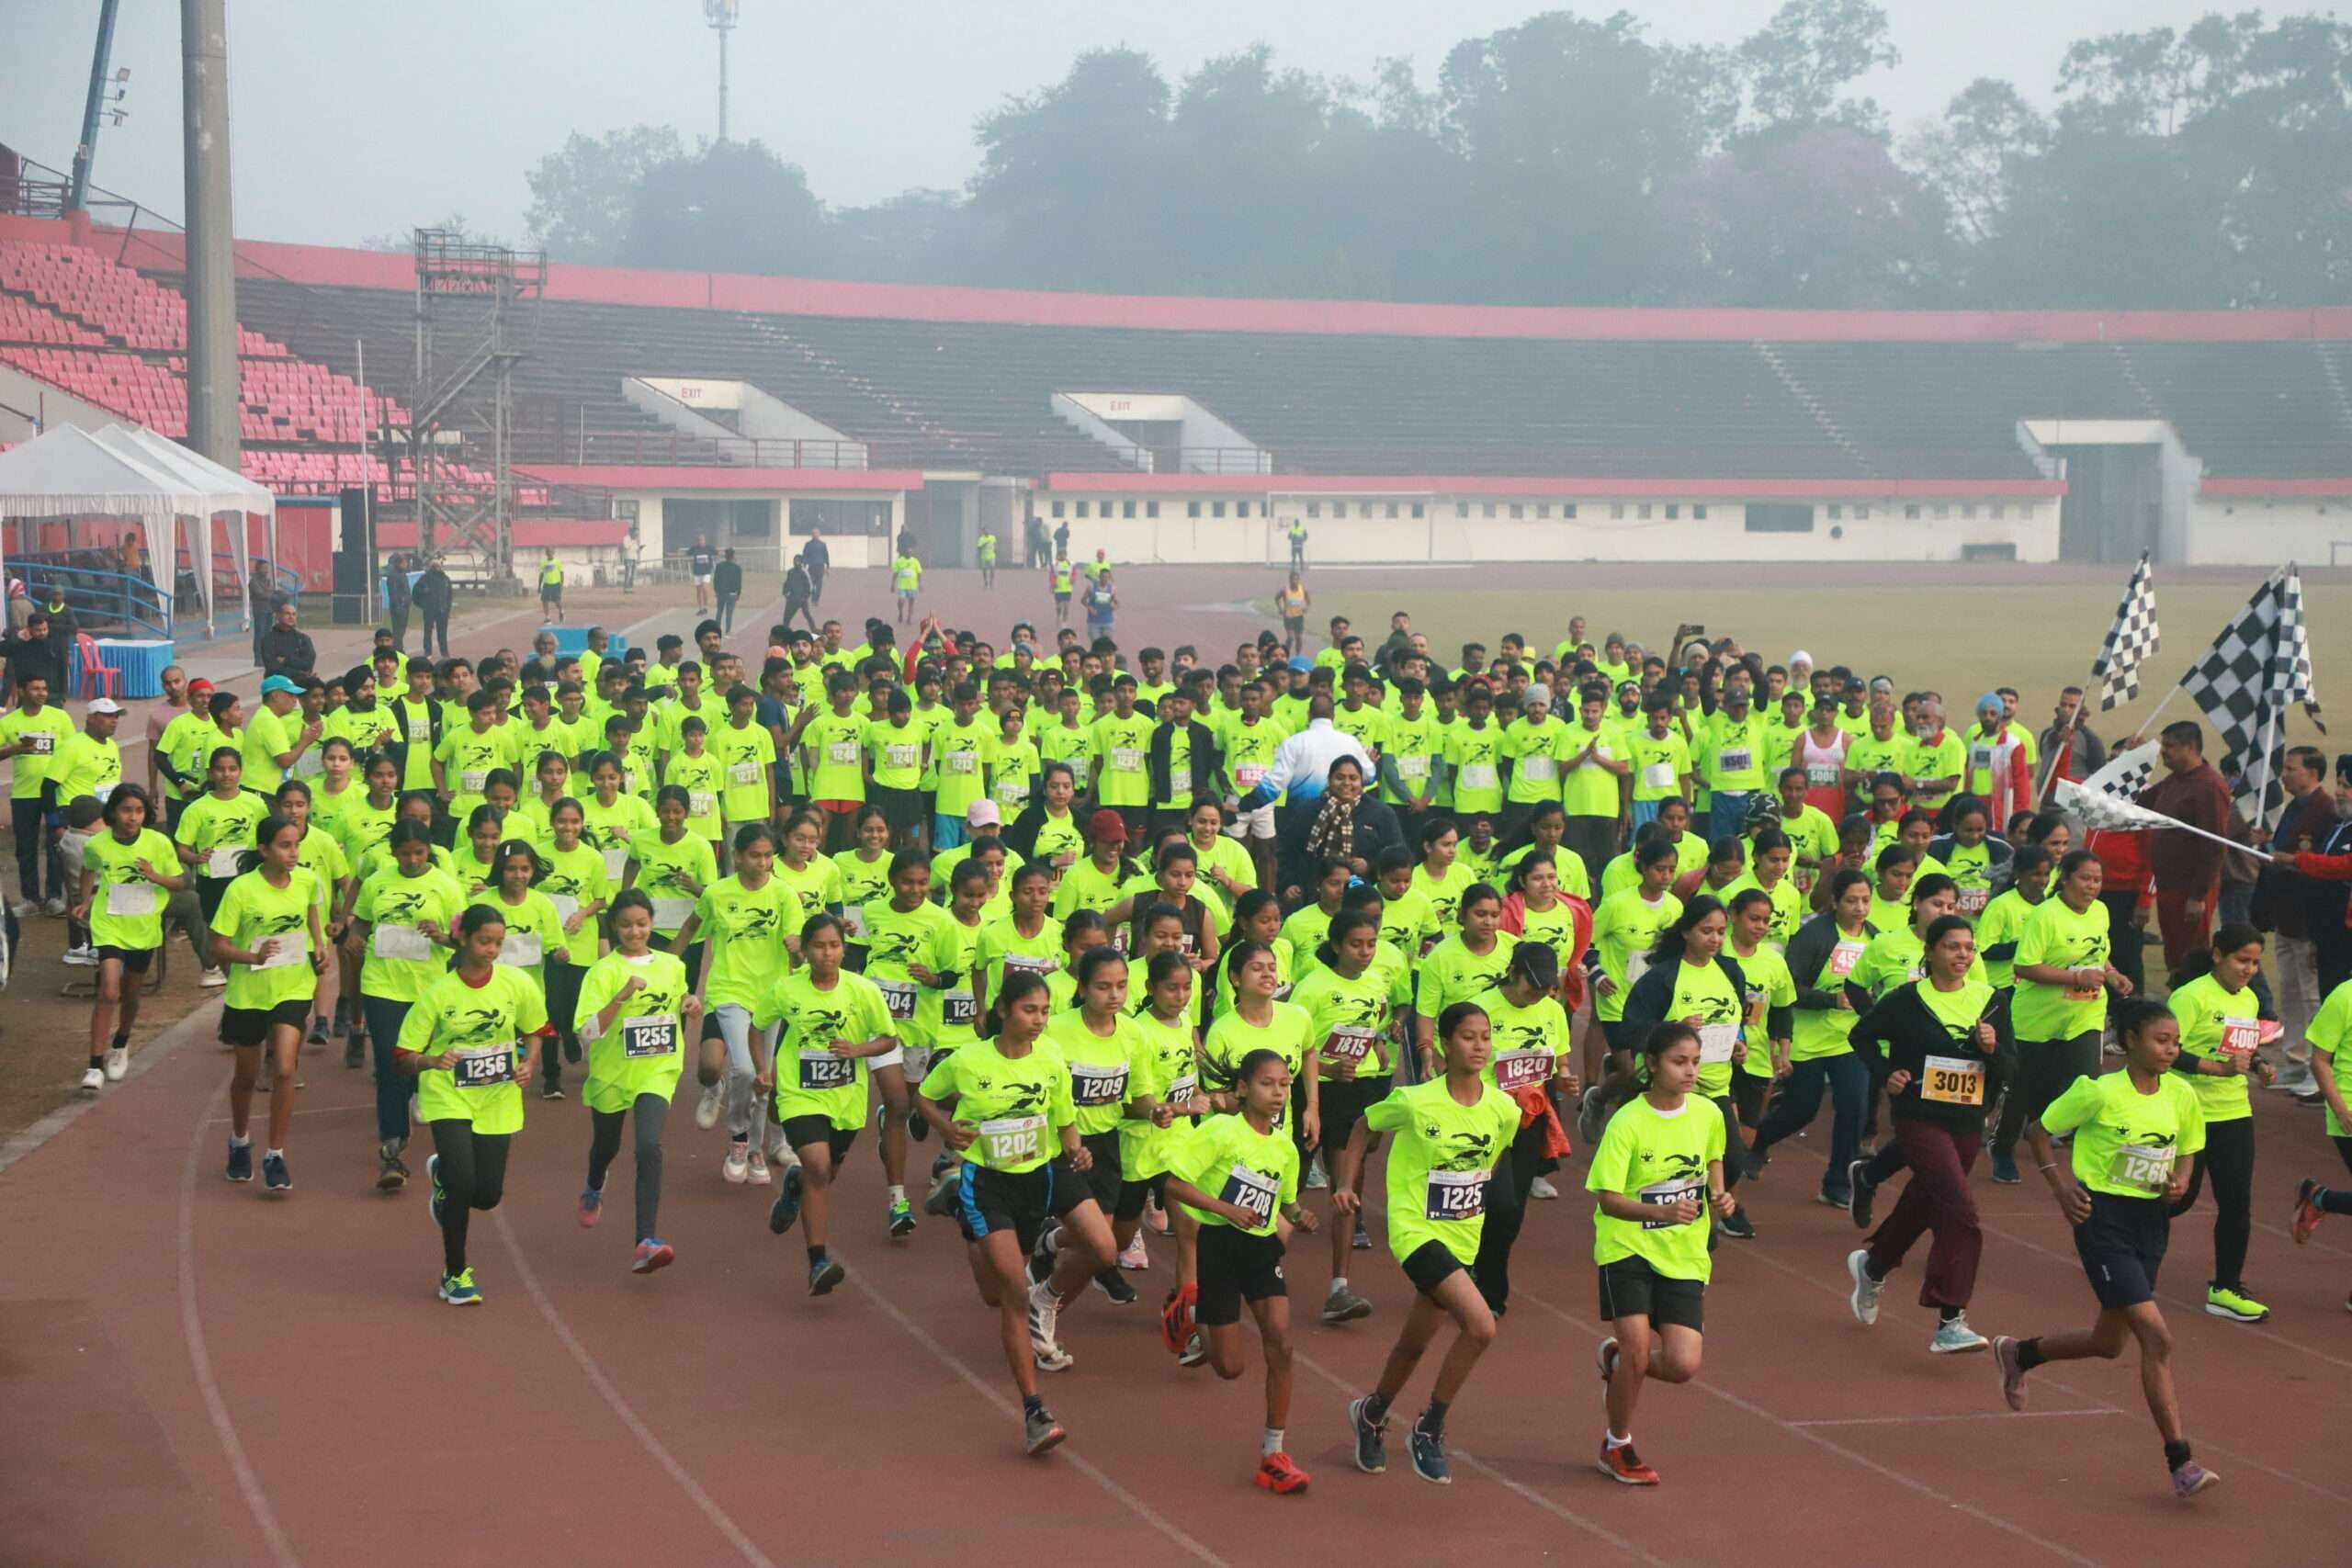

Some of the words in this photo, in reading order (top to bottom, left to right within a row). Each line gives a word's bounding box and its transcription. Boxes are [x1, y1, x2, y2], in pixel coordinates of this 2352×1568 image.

[682, 388, 701, 398] EXIT
[1110, 400, 1132, 412] EXIT
[634, 1026, 671, 1048] 1255
[1334, 1036, 1368, 1057] 1815
[2228, 1028, 2260, 1050] 4003
[465, 1055, 506, 1078] 1256
[810, 1058, 852, 1081] 1224
[1506, 1057, 1548, 1078] 1820
[1082, 1077, 1124, 1099] 1209
[1934, 1071, 1976, 1094] 3013
[990, 1131, 1038, 1158] 1202
[1233, 1183, 1272, 1217] 1208
[1442, 1184, 1483, 1211] 1225
